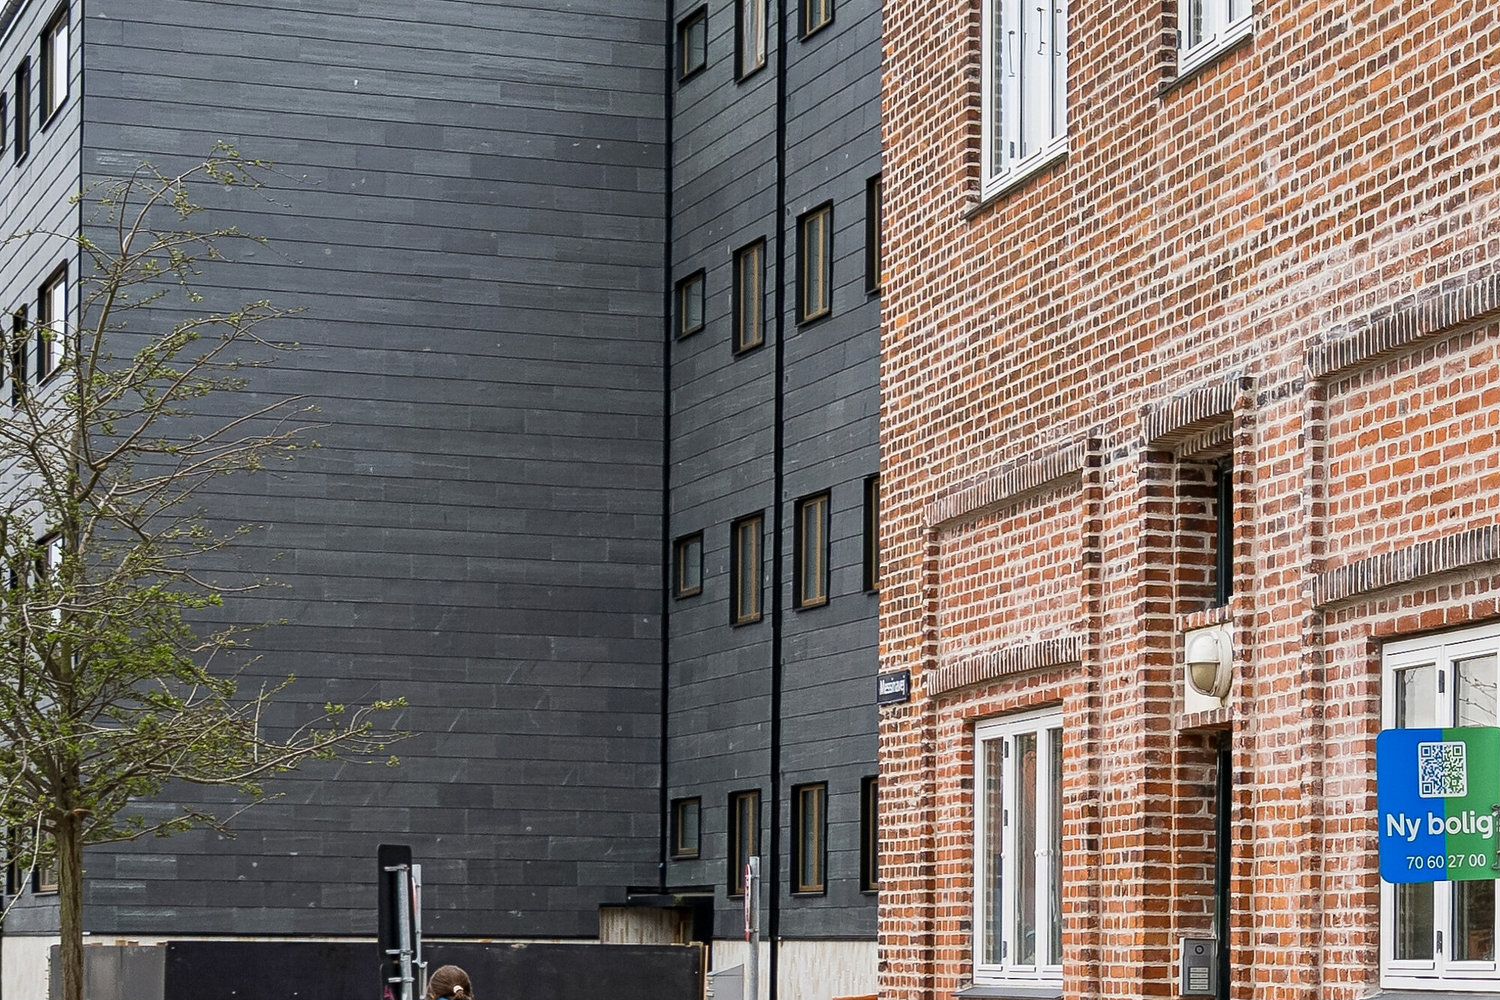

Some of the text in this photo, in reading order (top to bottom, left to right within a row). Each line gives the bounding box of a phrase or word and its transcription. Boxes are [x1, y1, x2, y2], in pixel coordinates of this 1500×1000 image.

[1386, 812, 1421, 842] Ny
[1406, 854, 1487, 870] 70 60 27 00
